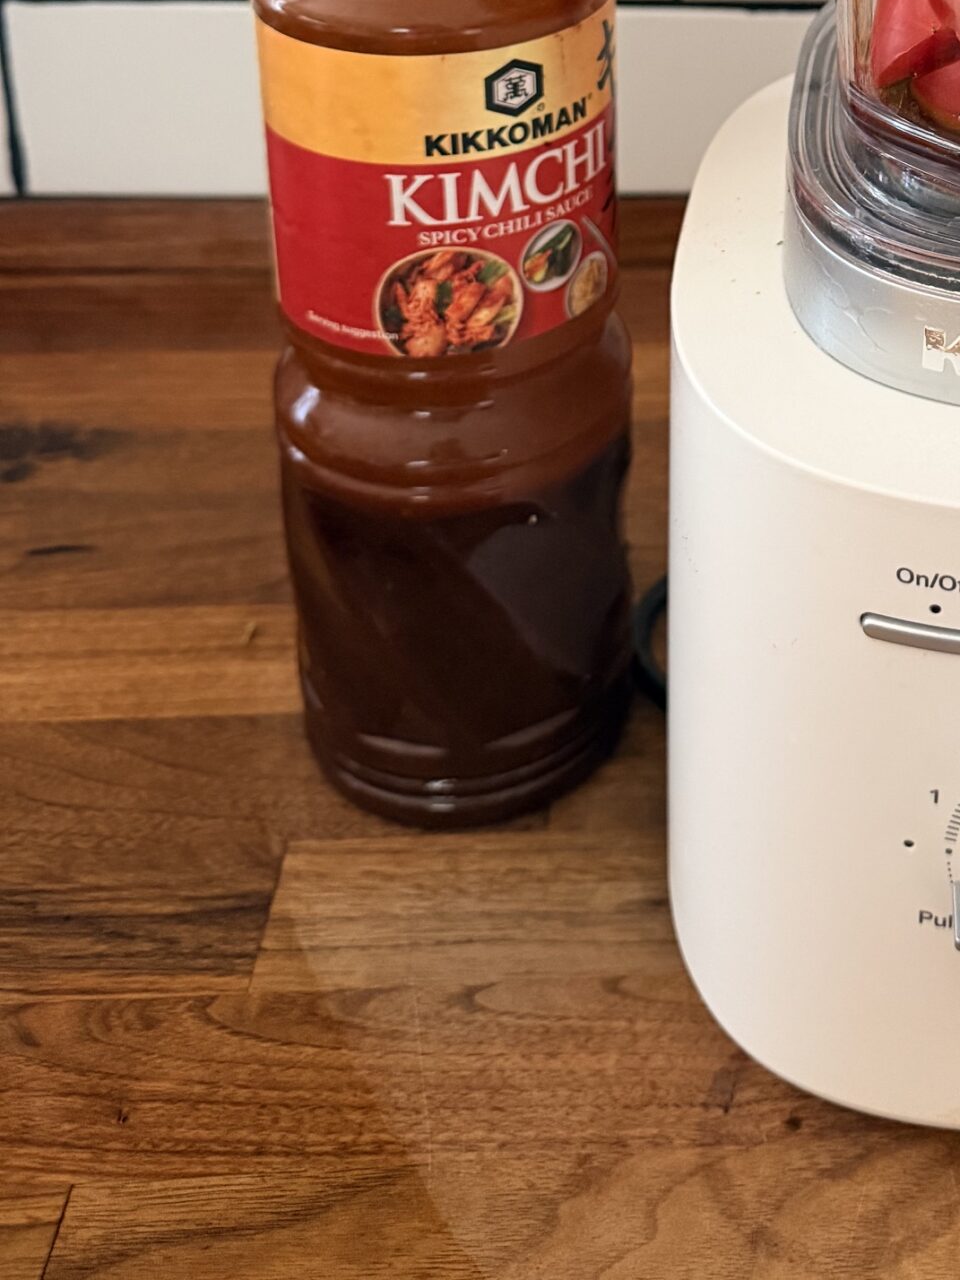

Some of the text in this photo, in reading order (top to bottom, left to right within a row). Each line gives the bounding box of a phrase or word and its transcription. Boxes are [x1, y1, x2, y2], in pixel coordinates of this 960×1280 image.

[424, 96, 587, 157] KIKKOMAN
[383, 120, 606, 226] KIMCHI
[418, 188, 594, 246] SPICY CHILI SAUCE
[929, 790, 939, 804] 1
[918, 910, 954, 928] Pul
